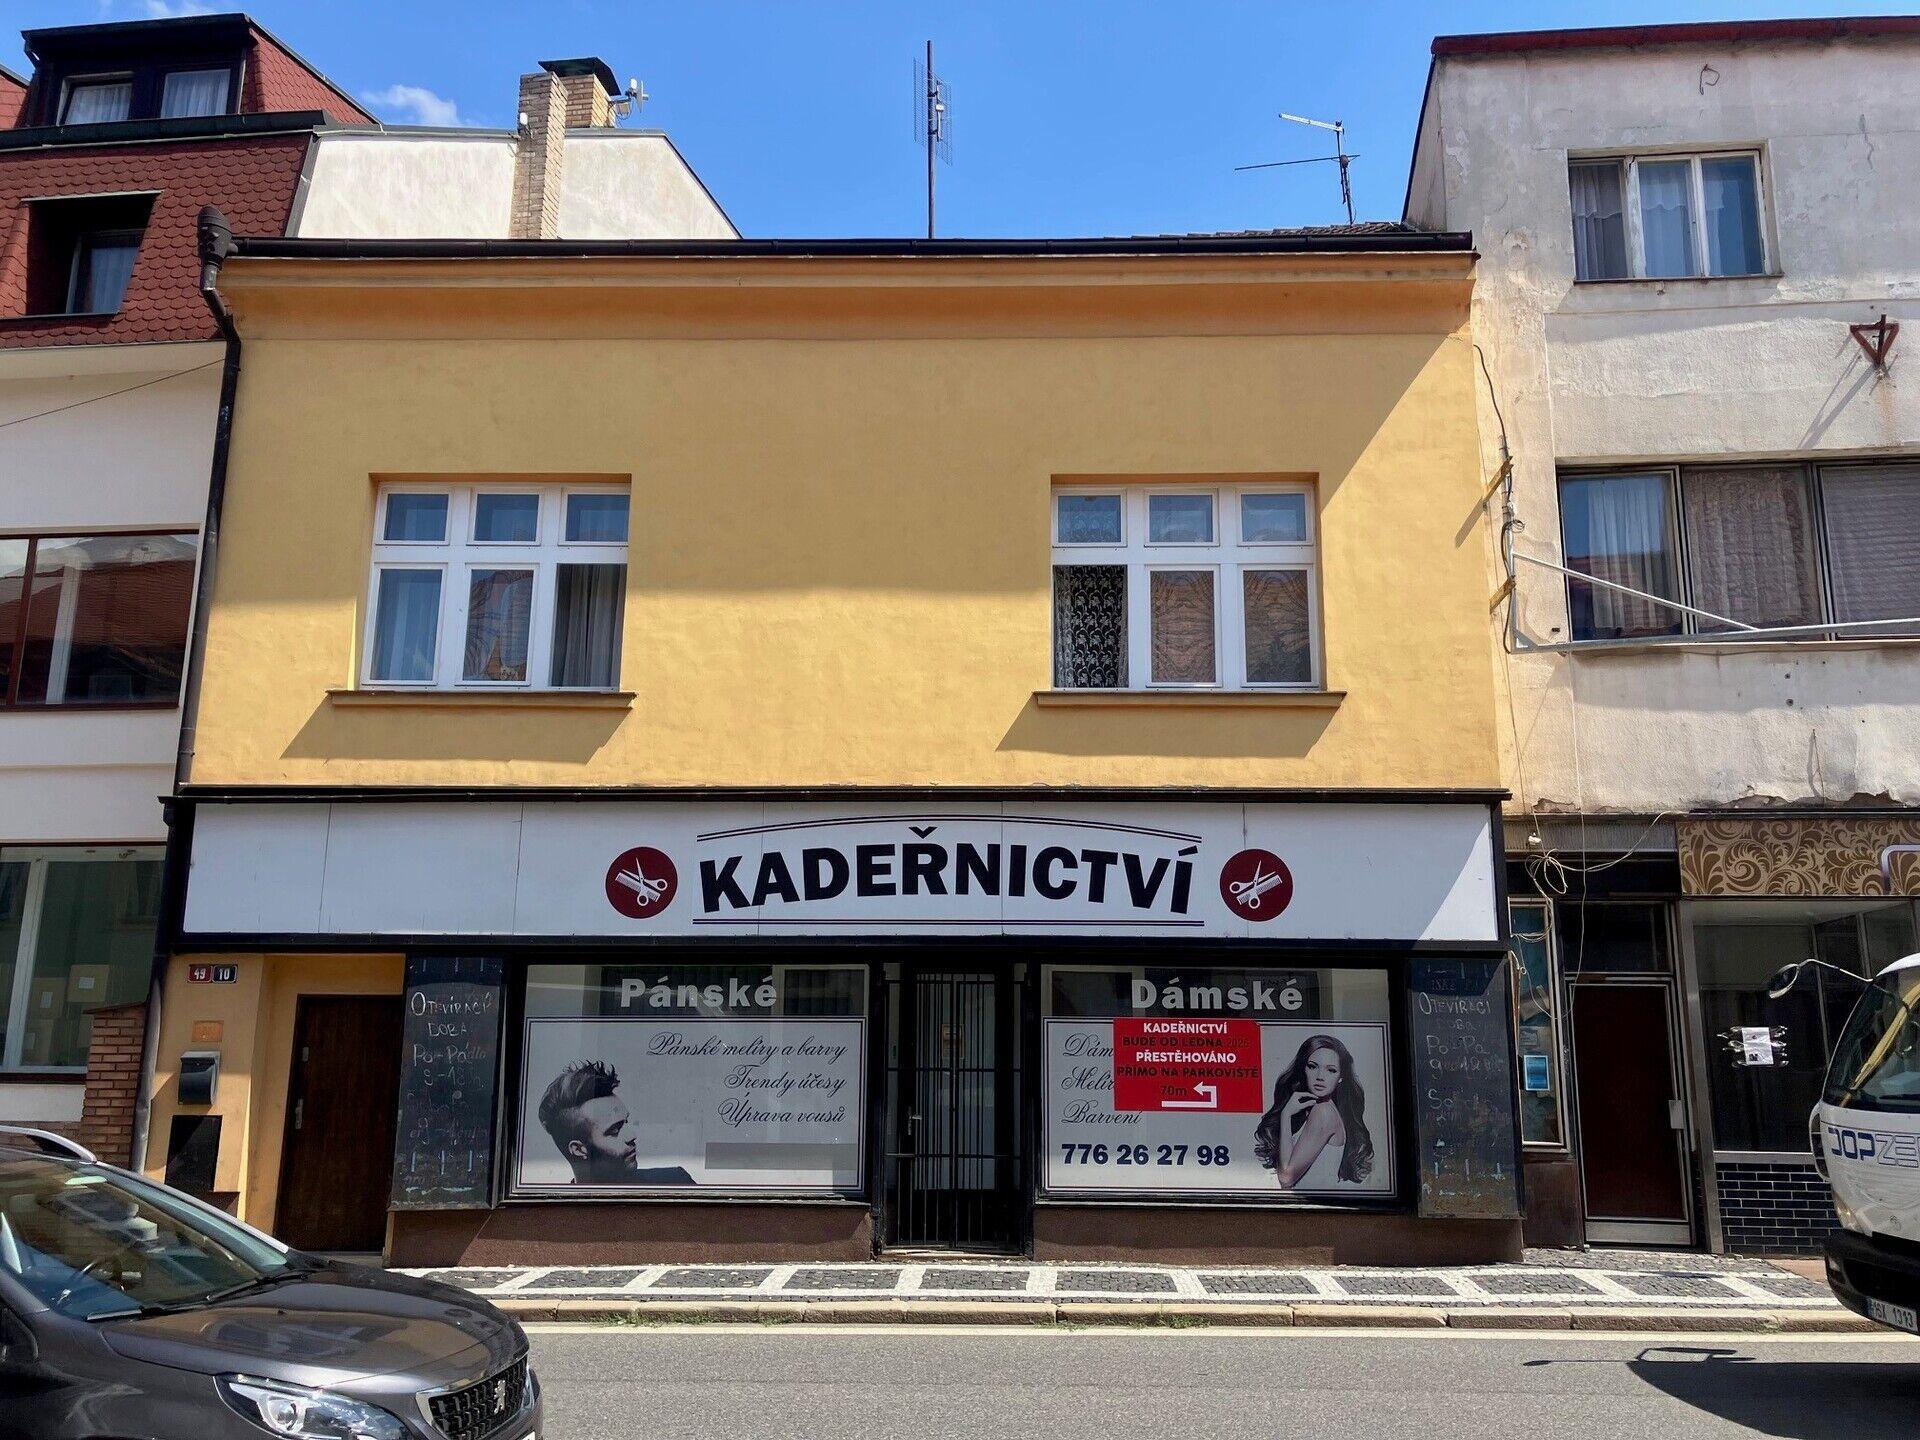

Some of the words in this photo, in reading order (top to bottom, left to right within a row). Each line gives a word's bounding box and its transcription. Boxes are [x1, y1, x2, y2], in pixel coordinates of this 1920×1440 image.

[700, 826, 1198, 915] KADEŘNICTVÍ
[219, 967, 230, 980] 10
[620, 975, 777, 1008] Pánské
[1132, 977, 1303, 1010] Dámské
[1143, 1021, 1228, 1034] KADEŘNICTVÍ
[647, 1031, 721, 1056] Pánské
[724, 1034, 780, 1064] melíry
[781, 1045, 795, 1056] a
[796, 1035, 849, 1064] barvy
[1062, 1033, 1114, 1057] Dám
[1122, 1036, 1156, 1047] BUDE
[1160, 1036, 1178, 1047] OD
[1182, 1036, 1222, 1048] LEDNA
[1136, 1049, 1237, 1063] PŘESTĚHOVÁNO
[723, 1064, 797, 1098] Trendy
[798, 1072, 849, 1098] účesy
[1161, 1066, 1178, 1076] NA
[717, 1092, 794, 1129] Úprava
[797, 1105, 846, 1123] vousů
[1061, 1099, 1143, 1124] Barvení
[1061, 1144, 1109, 1166] 776
[1116, 1144, 1149, 1166] 26
[1157, 1144, 1189, 1167] 27
[1197, 1144, 1230, 1167] 98
